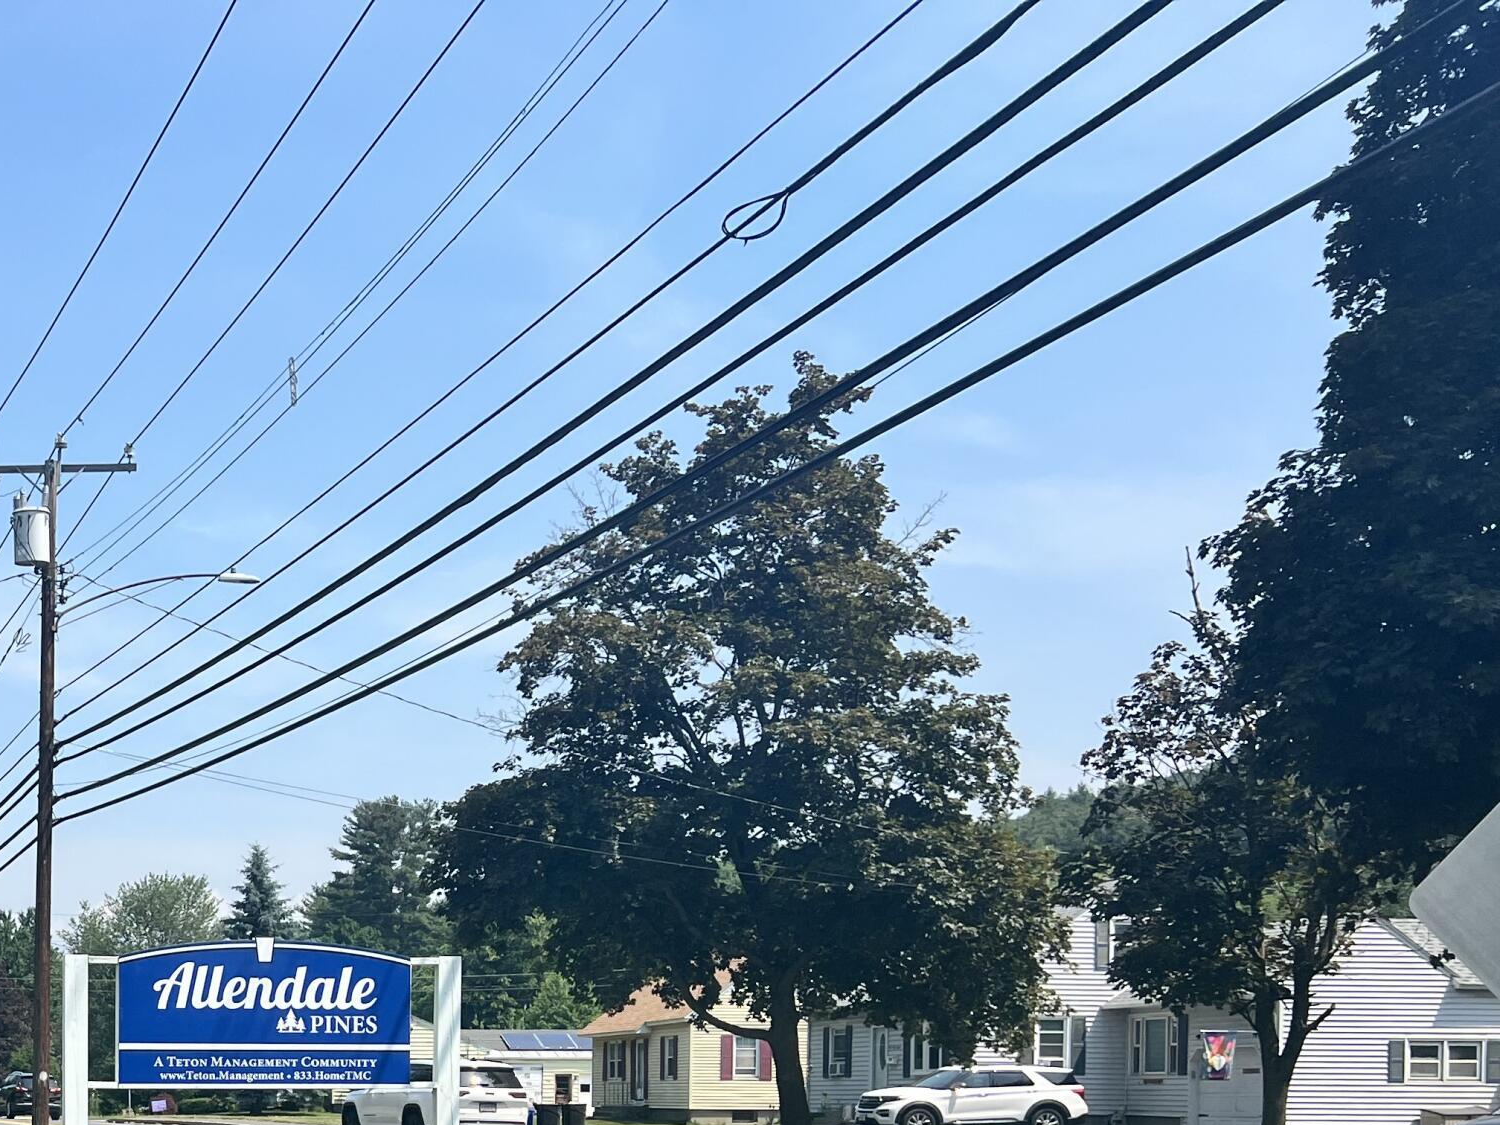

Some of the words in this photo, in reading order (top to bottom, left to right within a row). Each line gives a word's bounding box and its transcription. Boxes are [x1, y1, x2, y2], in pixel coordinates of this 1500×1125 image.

[152, 961, 378, 1011] Allendale
[309, 1015, 378, 1034] PINES
[153, 1056, 164, 1067] A
[160, 1070, 284, 1083] www.Teton.Management
[293, 1070, 372, 1081] 833.HomeTMC
